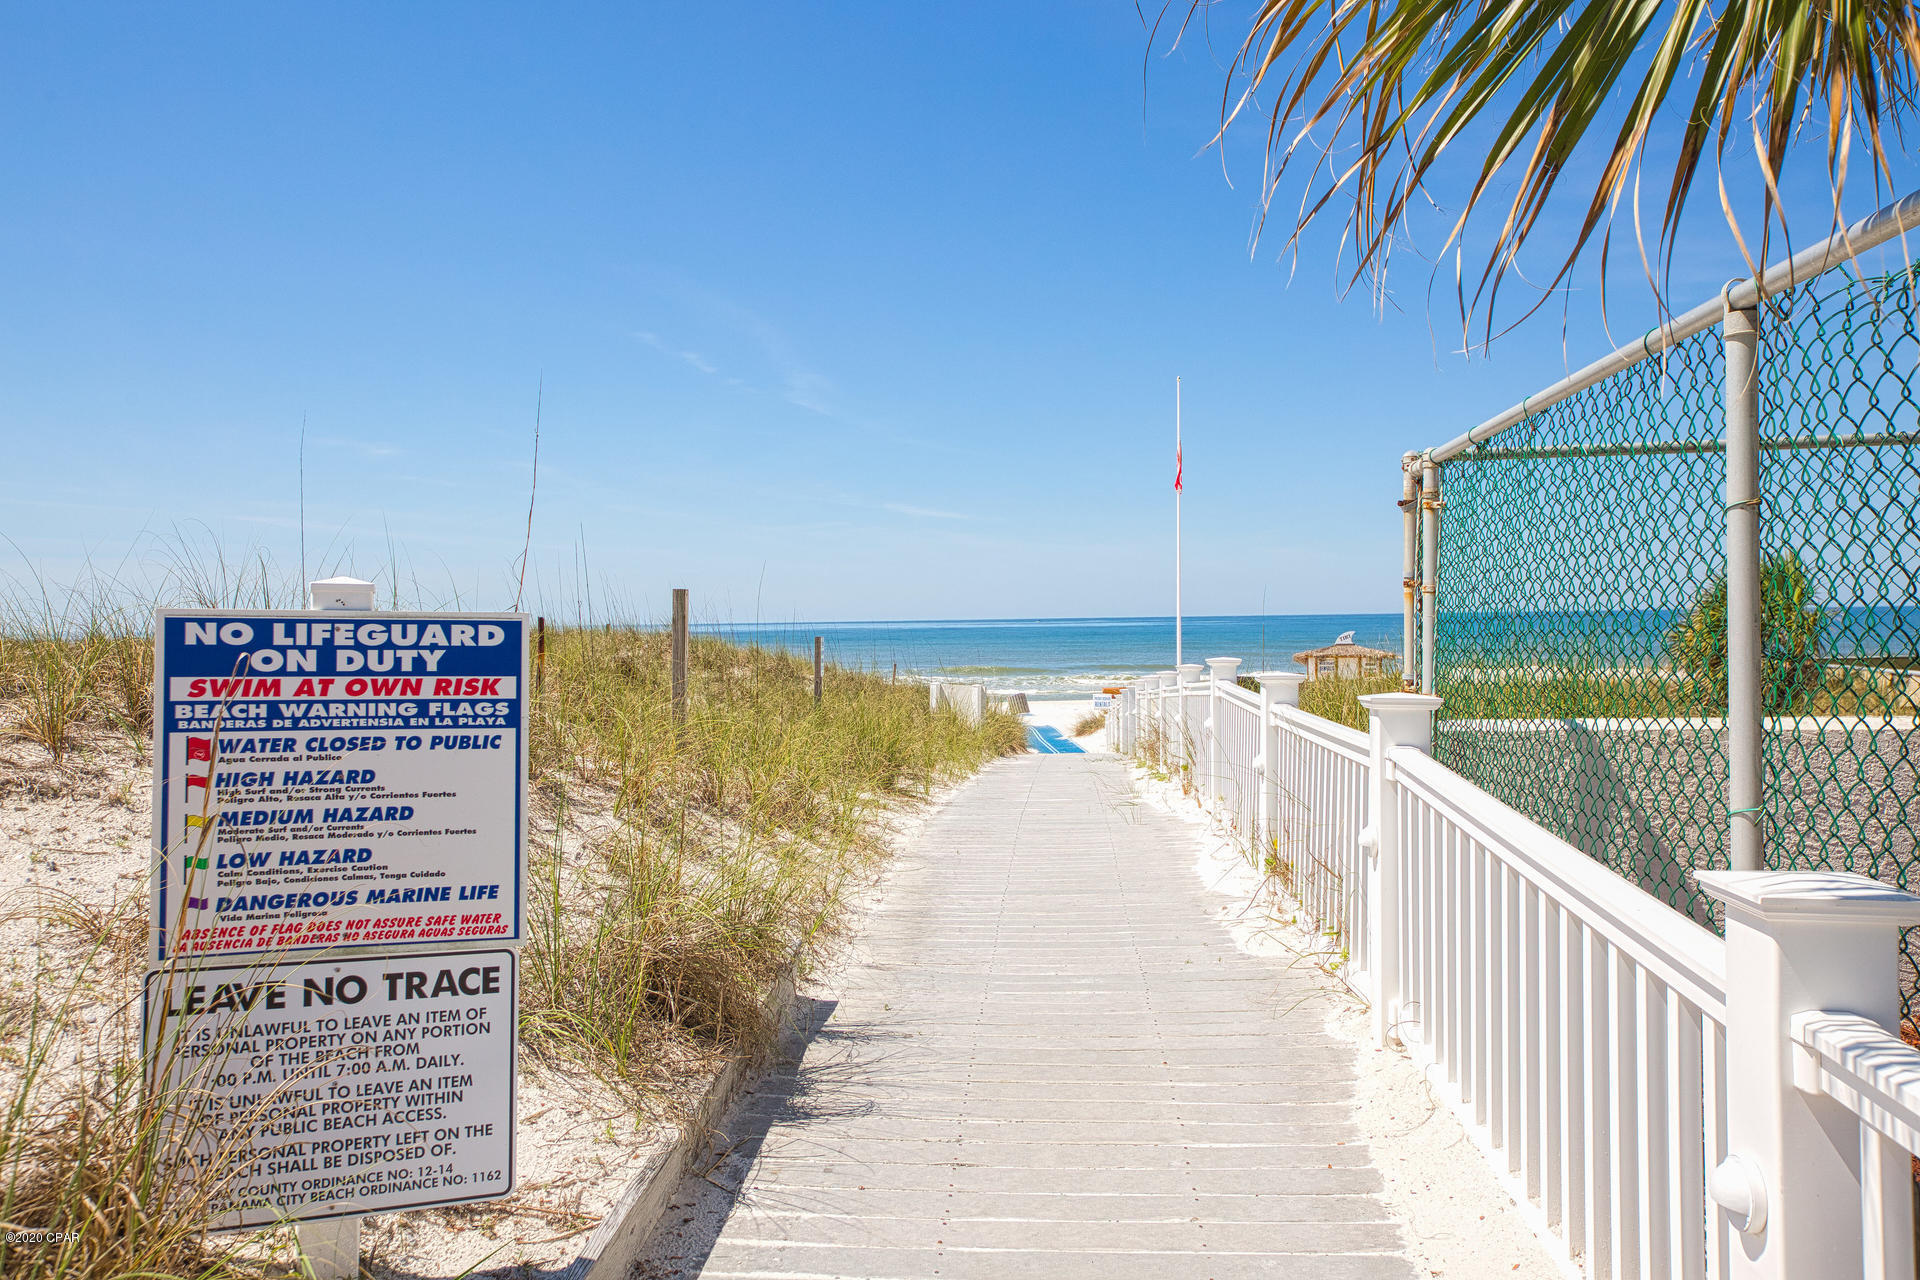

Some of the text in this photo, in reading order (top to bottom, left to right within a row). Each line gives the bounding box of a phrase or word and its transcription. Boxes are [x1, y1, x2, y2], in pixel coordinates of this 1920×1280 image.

[184, 622, 504, 647] NO LIFEGUARD
[250, 649, 446, 672] ON DUTY
[187, 678, 502, 698] SWIM AT OWN RISK
[174, 702, 509, 719] BEACH WARNING FLAGS
[177, 717, 506, 729] BANDERAS DE ADVERTENSIA EN LA PLAYA
[218, 735, 501, 753] WATER CLOSED TO PUBLIC
[215, 770, 376, 787] HIGH HAZARD
[217, 789, 241, 797] High
[269, 786, 305, 794] and/or
[218, 806, 414, 827] MEDIUM HAZARD
[217, 835, 252, 845] Peligro
[377, 830, 393, 838] y/o
[218, 827, 265, 835] Moderate
[290, 825, 324, 833] and/or
[327, 824, 364, 832] Currents
[216, 848, 372, 869] LOW HAZARD
[247, 867, 303, 876] Conditions,
[307, 866, 348, 874] Exercise
[217, 879, 252, 888] Peligro
[256, 878, 280, 886] Bajo,
[283, 875, 338, 883] Condiciones
[380, 872, 407, 880] Tenga
[216, 885, 499, 913] DANGEROUS MARINE LIFE
[181, 913, 501, 941] ABSENCE OF FLAG DOES NOT ASSURE SAFE WATER
[283, 910, 328, 919] Peligrosa
[173, 925, 508, 953] A AUSENCIA DE BANDERAS NO ASEGURA AGUAS SEGURAS
[163, 966, 500, 1017] LEAVE NO TRACE
[196, 1028, 210, 1041] IS
[316, 1019, 338, 1032] TO
[344, 1015, 391, 1030] LEAVE
[396, 1012, 420, 1025] AN
[426, 1010, 461, 1023] ITEM
[466, 1008, 487, 1019] OF
[266, 1033, 346, 1051] PROPERTY
[352, 1031, 377, 1044] ON
[382, 1028, 417, 1042] ANY
[422, 1022, 490, 1039] PORTION
[251, 1043, 420, 1068] OF THE BEACH FROM
[243, 1070, 276, 1084] P.M.
[283, 1065, 331, 1081] UNTIL
[337, 1062, 370, 1076] 7:00
[376, 1059, 410, 1073] A.M.
[416, 1054, 464, 1069] DAILY.
[209, 1097, 223, 1110] IS
[328, 1086, 350, 1099] TO
[357, 1080, 403, 1096] LEAVE
[409, 1078, 432, 1092] AN
[438, 1075, 472, 1088] ITEM
[322, 1095, 399, 1116] PROPERTY
[405, 1090, 463, 1107] WITHIN
[261, 1120, 317, 1137] PUBLIC
[324, 1114, 377, 1131] BEACH
[382, 1107, 446, 1125] ACCESS.
[312, 1134, 391, 1154] PROPERTY
[396, 1131, 429, 1145] LEFT
[434, 1127, 459, 1140] ON
[464, 1124, 493, 1137] THE
[208, 1143, 456, 1181] EACH SHALL BE DISPOSED OF.
[238, 1181, 297, 1197] COUNTY
[302, 1171, 383, 1190] ORDINANCE
[388, 1168, 413, 1180] NO:
[418, 1163, 453, 1177] 12-14
[276, 1193, 306, 1206] CITY
[311, 1188, 355, 1200] BEACH
[359, 1178, 438, 1196] ORDINANCE
[443, 1175, 467, 1186] NO:
[472, 1170, 501, 1182] 1162
